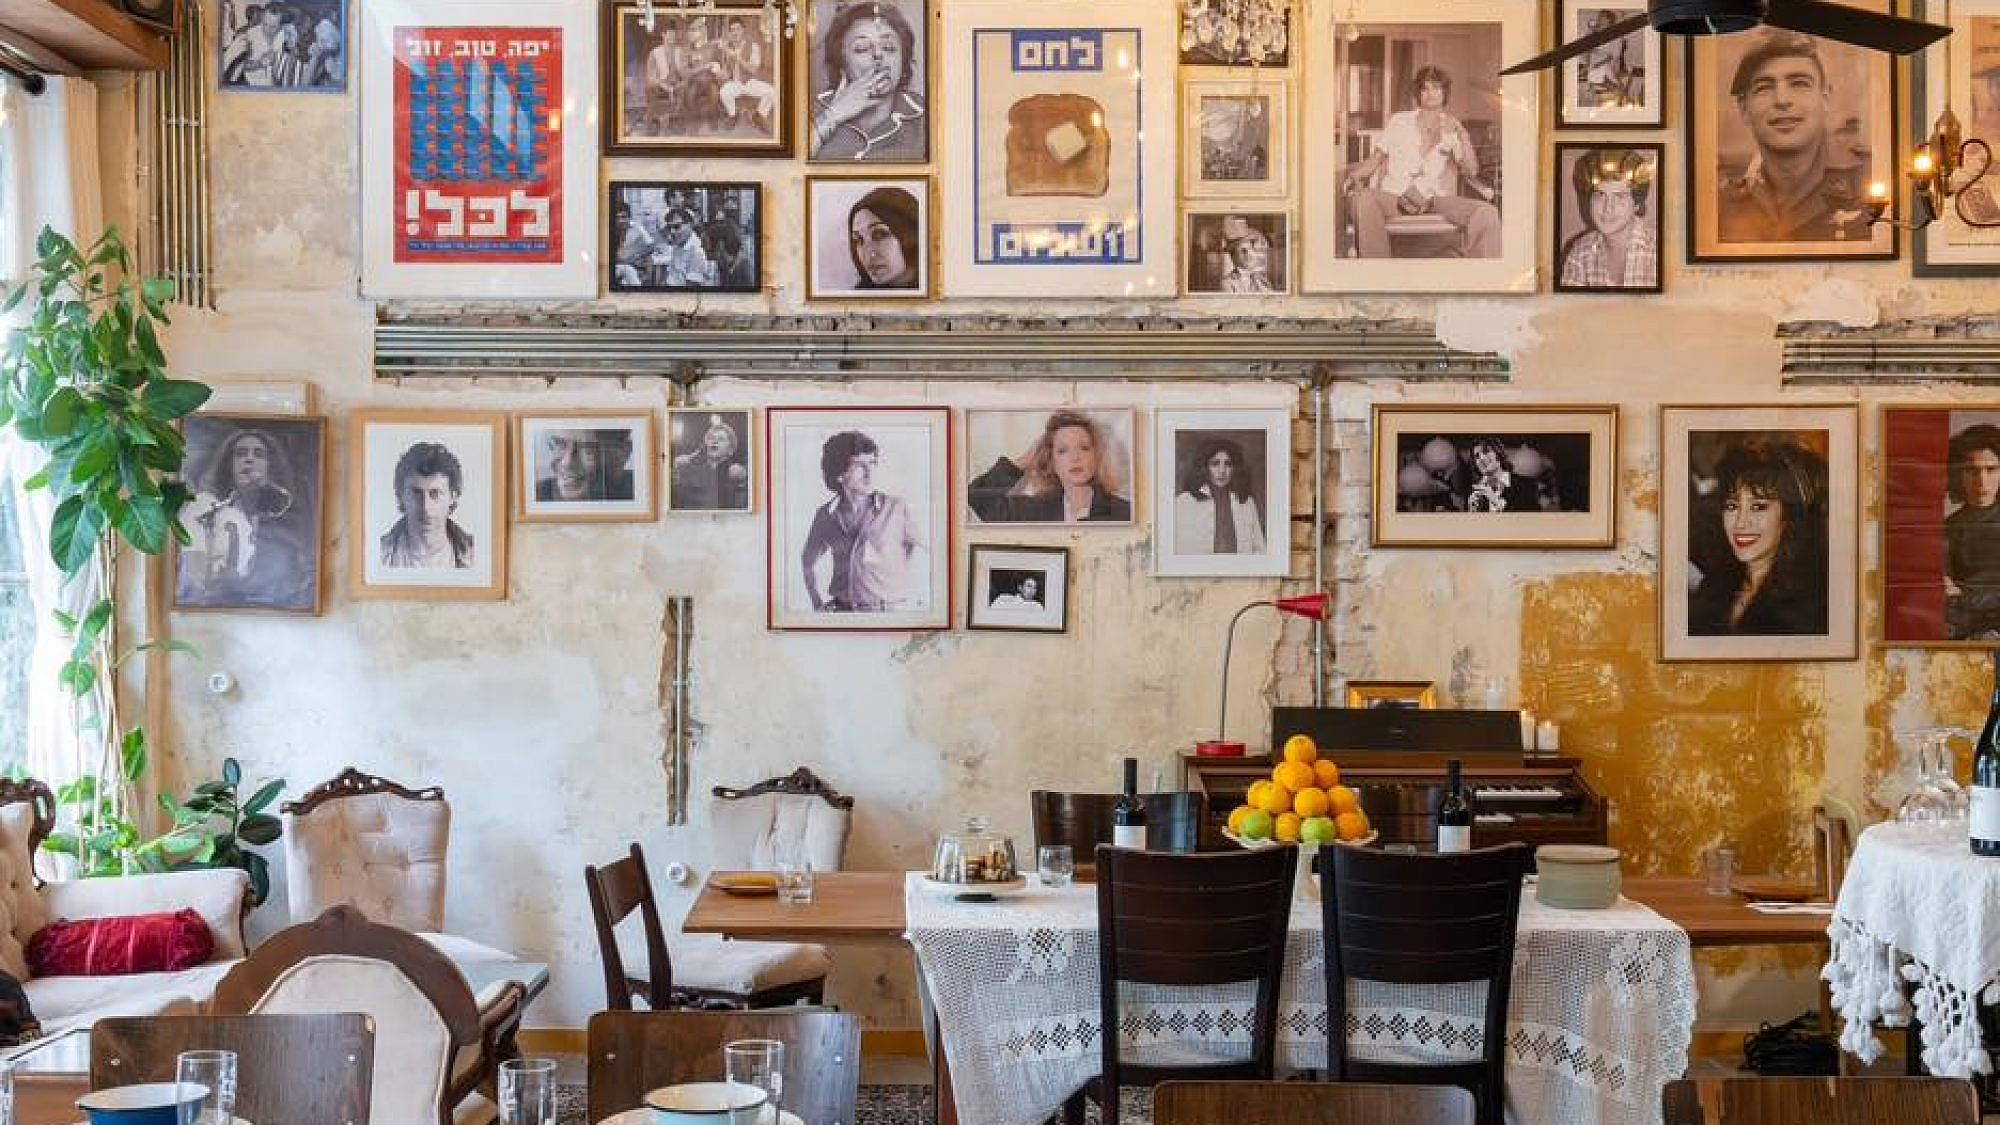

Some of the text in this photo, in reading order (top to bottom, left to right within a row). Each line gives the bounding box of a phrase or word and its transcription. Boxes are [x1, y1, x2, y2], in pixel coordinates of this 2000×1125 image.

[449, 40, 496, 59] טוב,
[503, 40, 549, 59] יפה,
[1019, 36, 1095, 66] לחם
[406, 190, 549, 236] לכל!
